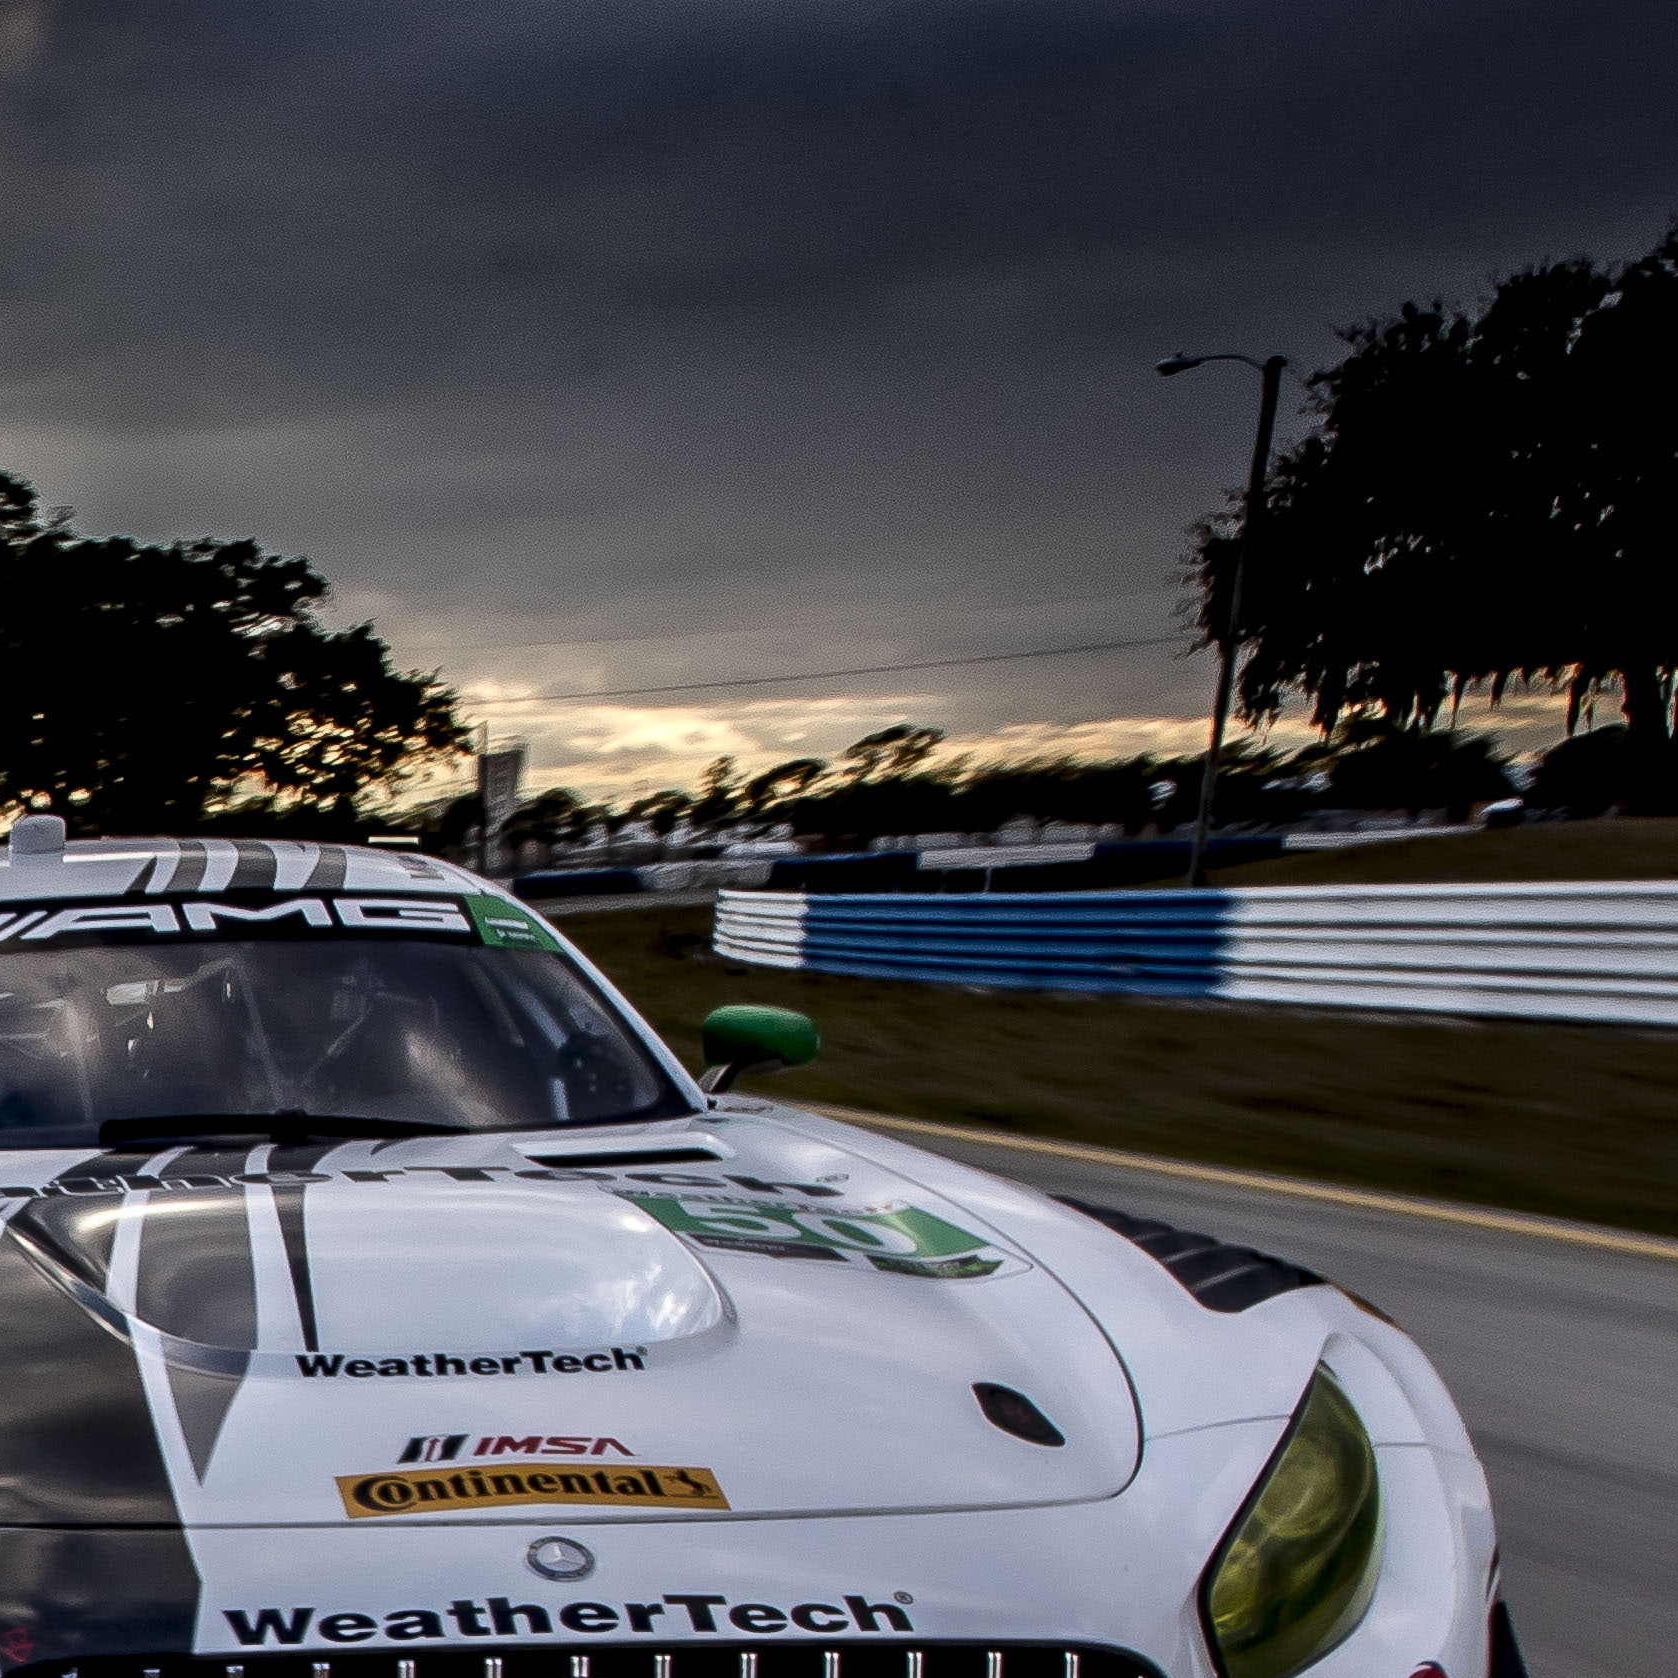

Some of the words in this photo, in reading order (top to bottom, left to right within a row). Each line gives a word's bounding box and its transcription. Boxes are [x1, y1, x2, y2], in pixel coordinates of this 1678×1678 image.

[18, 899, 472, 941] AMG
[678, 1201, 919, 1256] 50
[294, 1346, 646, 1379] WeatherTech
[473, 1436, 637, 1457] IMSA
[350, 1468, 665, 1513] Continental
[222, 1593, 917, 1646] WeatherTech
